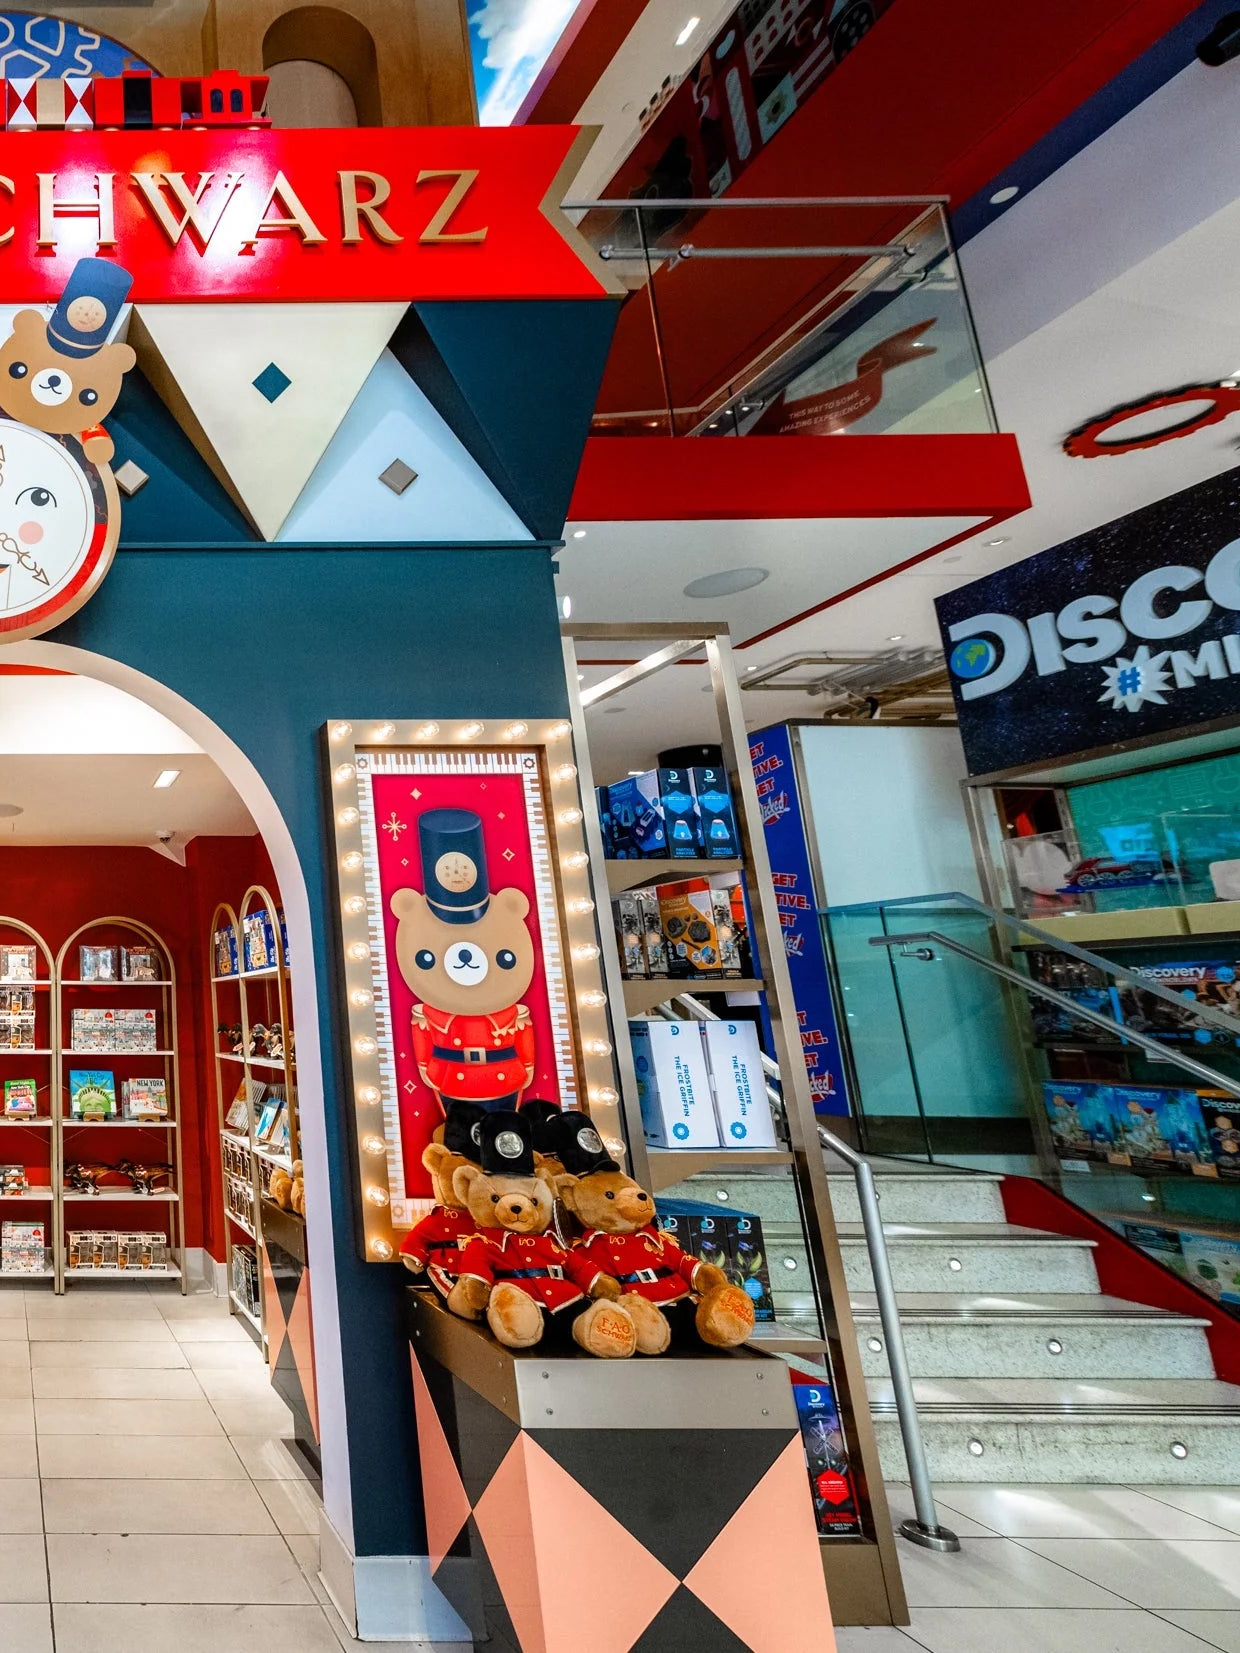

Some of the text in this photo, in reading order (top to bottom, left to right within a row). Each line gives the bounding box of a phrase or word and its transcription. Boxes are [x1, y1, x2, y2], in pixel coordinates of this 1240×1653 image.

[780, 394, 872, 433] AMAZING EXPERIENCES
[789, 390, 860, 419] THIS WAY TO SOME
[749, 741, 764, 760] ET
[752, 754, 784, 778] TIVE.
[756, 776, 775, 797] ET
[775, 892, 811, 910] TIVE.
[778, 912, 797, 928] ET
[803, 1052, 819, 1069] ET
[674, 1056, 682, 1070] THE
[680, 1086, 690, 1117] GRIFFIN
[682, 1064, 695, 1105] FROSTBITE
[734, 1071, 742, 1084] ICE
[740, 1063, 752, 1105] FROSTBITE
[737, 1086, 747, 1116] GRIFFIN
